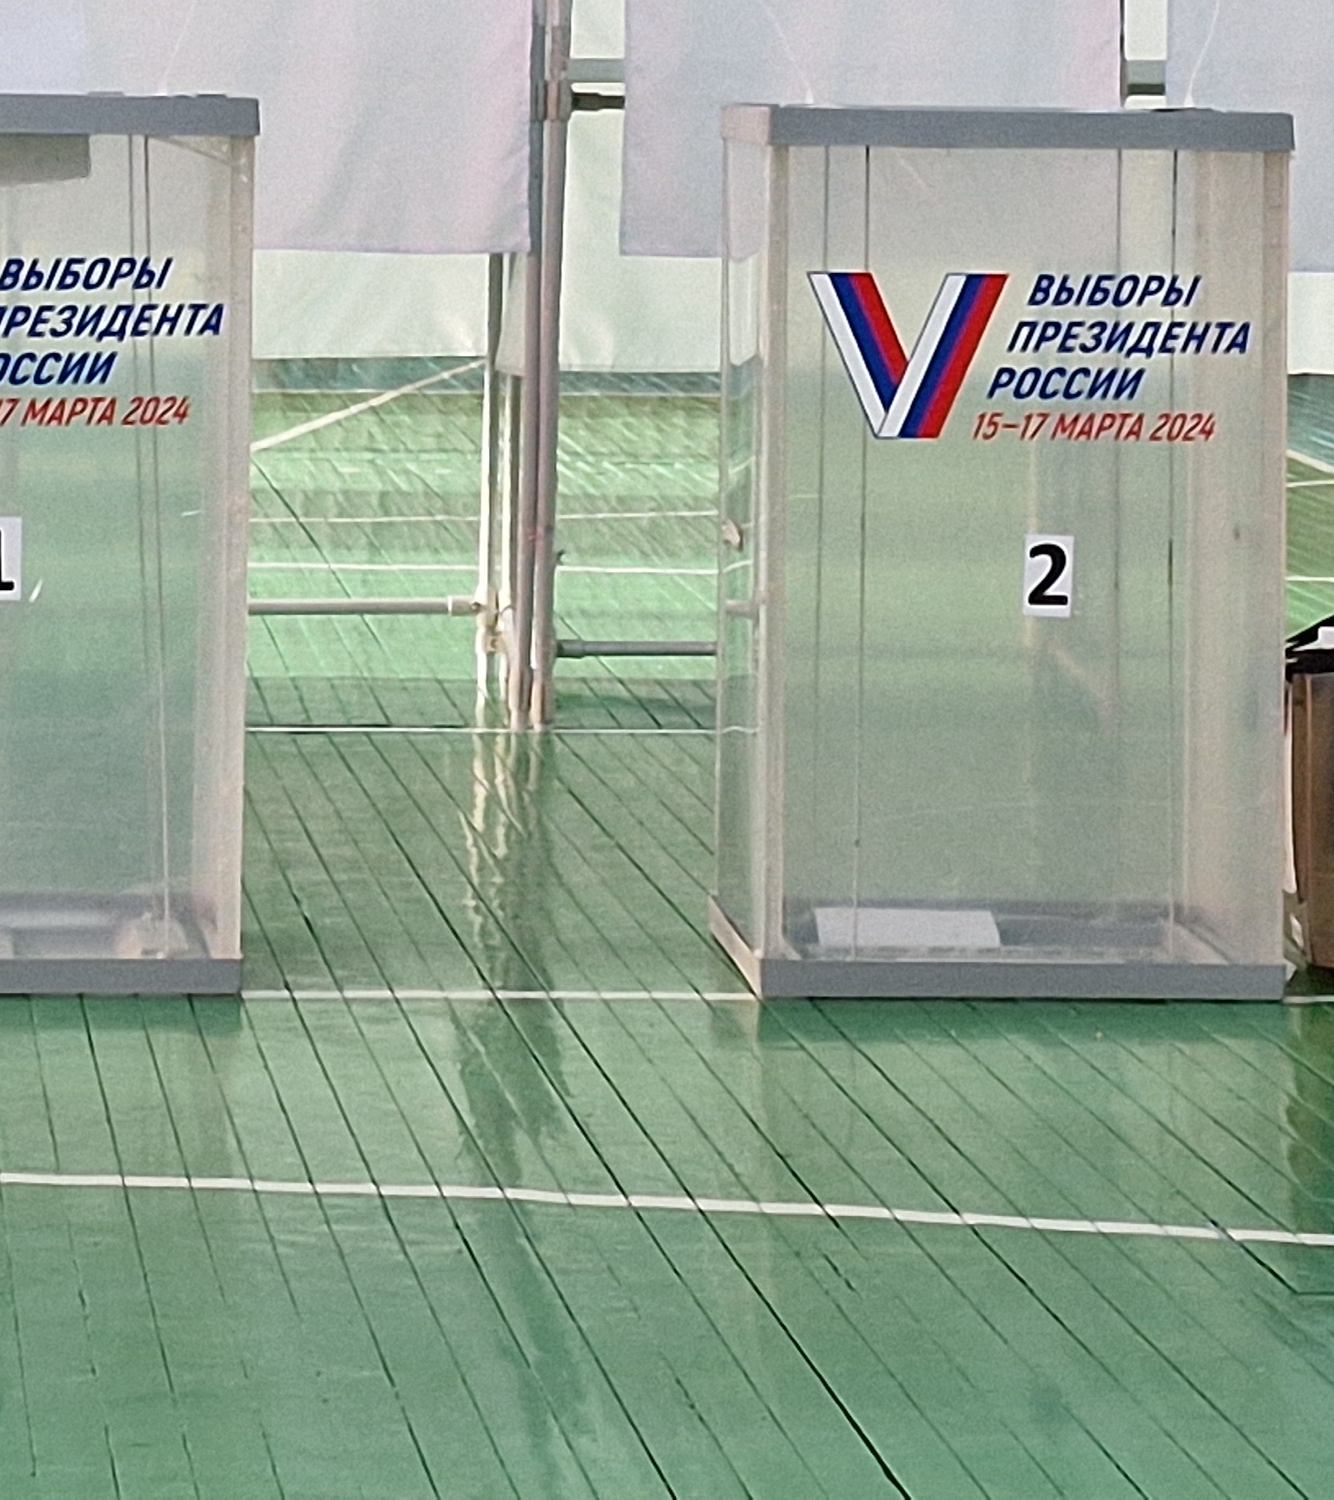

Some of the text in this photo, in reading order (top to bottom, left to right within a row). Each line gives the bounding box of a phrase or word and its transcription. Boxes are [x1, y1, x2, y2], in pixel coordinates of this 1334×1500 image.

[1027, 273, 1202, 308] ВЫБОРЫ
[1008, 321, 1251, 357] ПРЕЗИДЕНТА
[988, 367, 1145, 400] РОССИИ
[21, 398, 115, 426] МАРТА
[121, 397, 190, 425] 2024
[1050, 413, 1143, 441] МАРТА
[1149, 413, 1216, 441] 2024
[1028, 543, 1069, 606] 2
